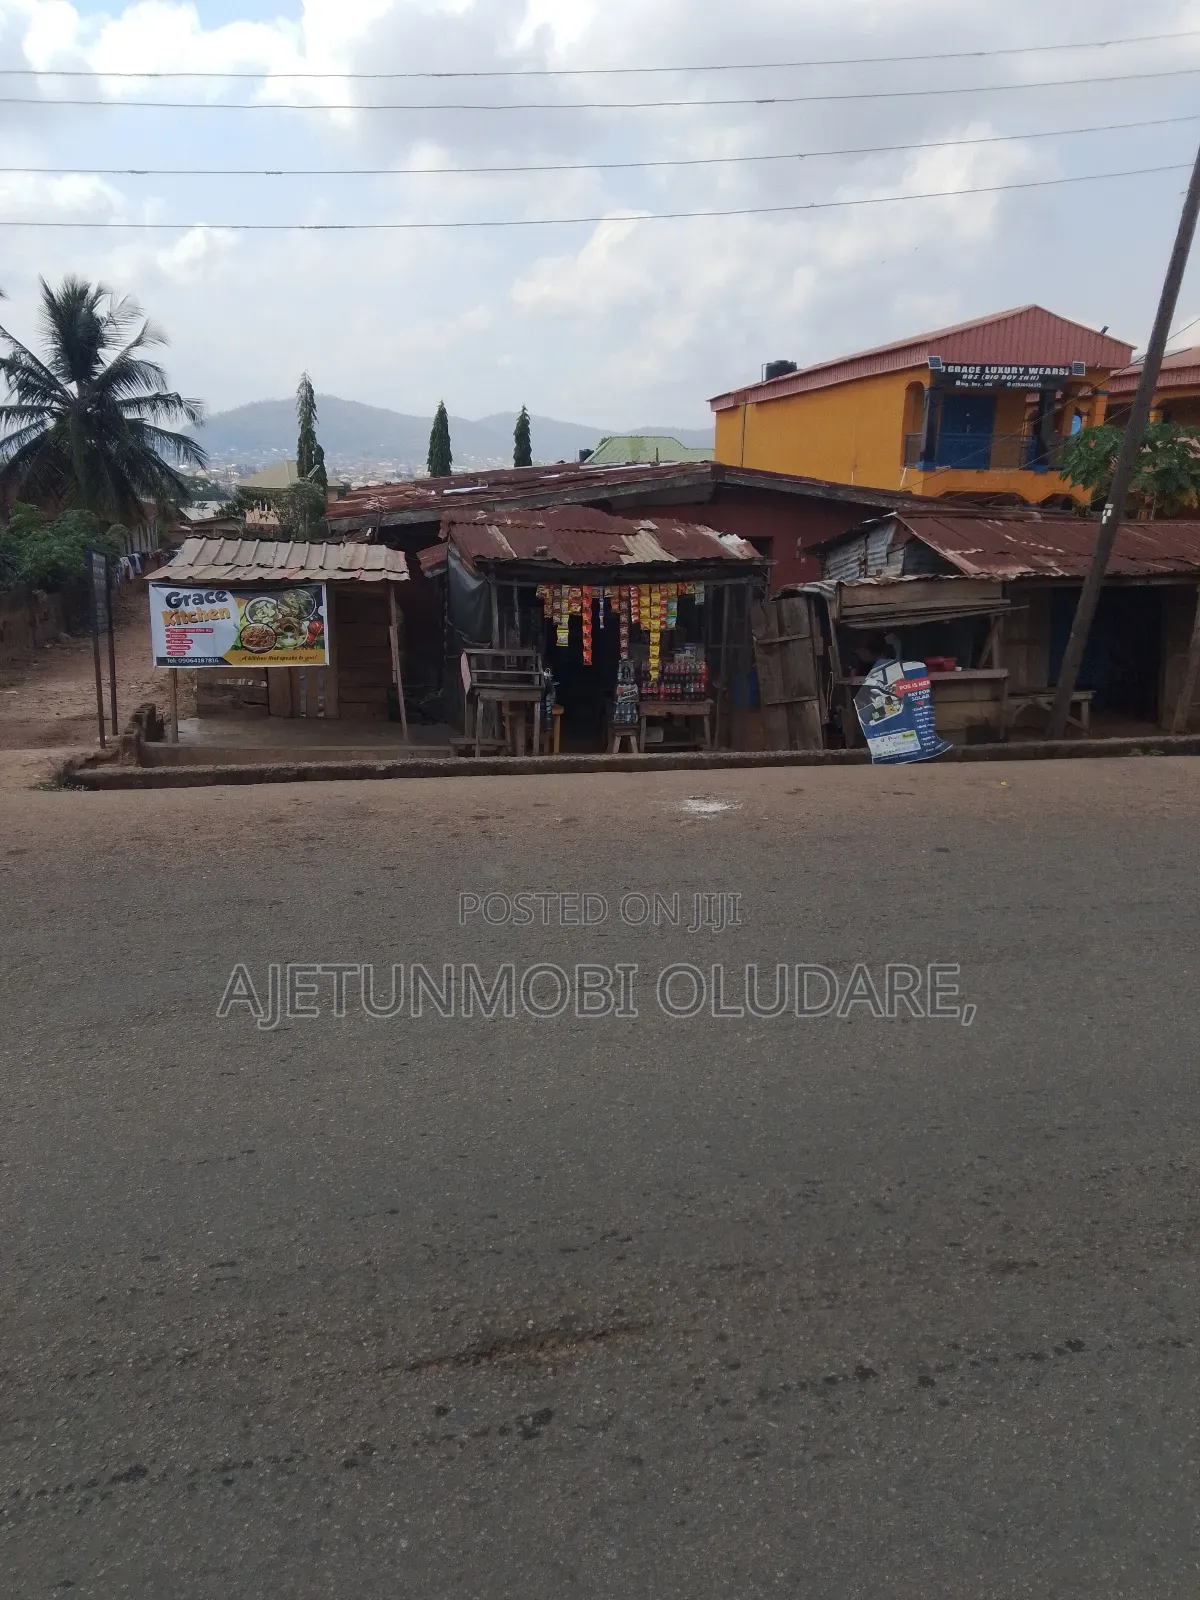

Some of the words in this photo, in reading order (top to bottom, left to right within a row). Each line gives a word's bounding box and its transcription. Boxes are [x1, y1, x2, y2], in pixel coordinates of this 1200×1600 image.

[948, 366, 981, 374] GRACE
[985, 366, 1024, 374] LUXURY
[165, 590, 228, 609] Grace
[162, 607, 231, 627] Kitchen
